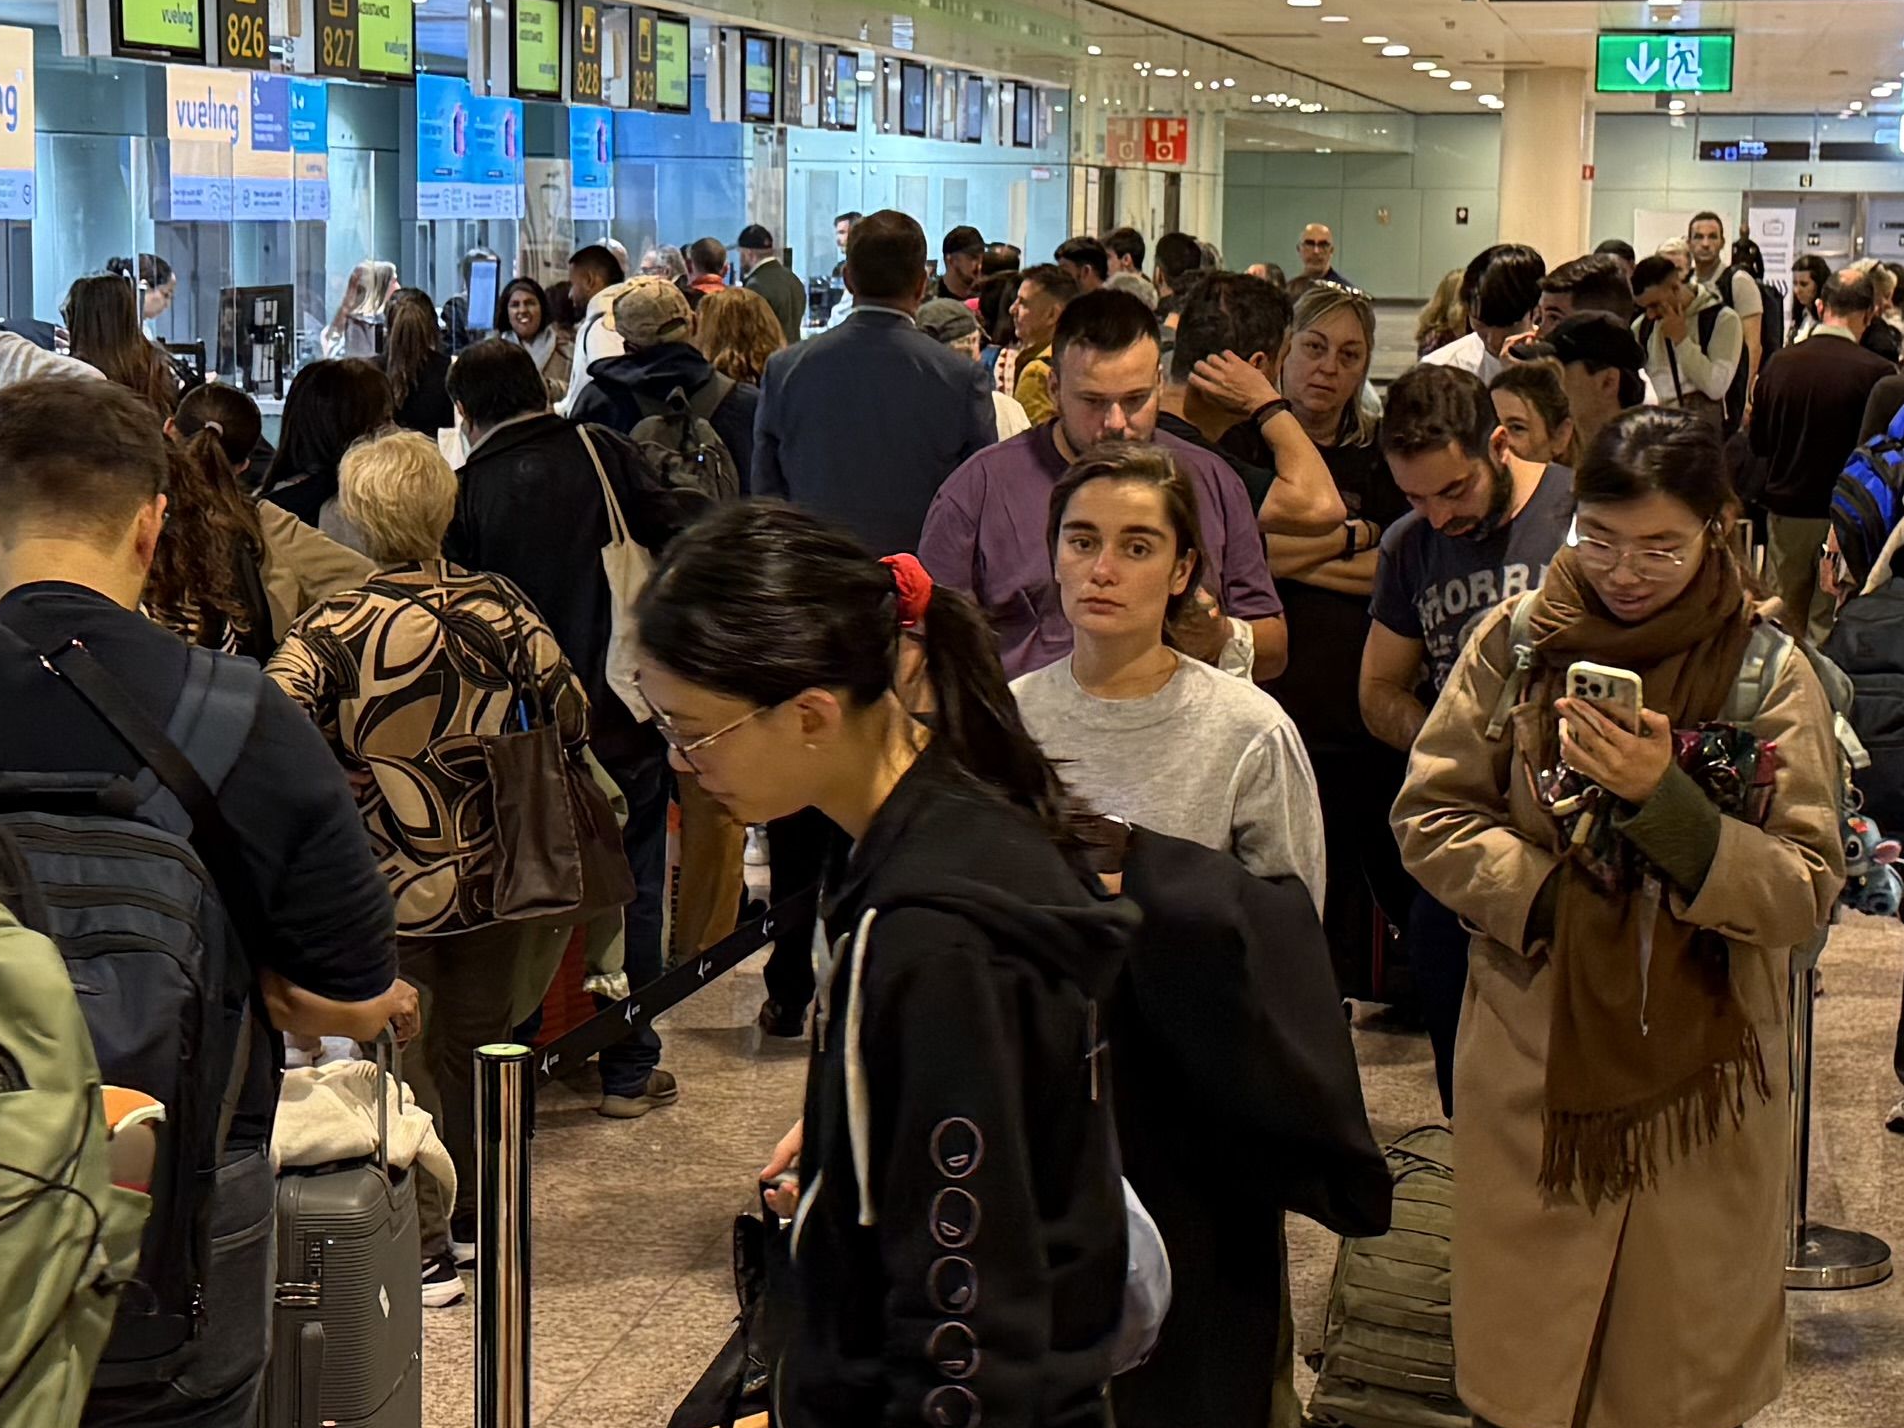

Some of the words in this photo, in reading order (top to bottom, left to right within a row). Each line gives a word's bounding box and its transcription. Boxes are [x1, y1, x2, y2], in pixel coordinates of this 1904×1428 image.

[227, 13, 264, 59] 826
[323, 26, 354, 67] 827
[577, 61, 599, 94] 828
[176, 86, 239, 144] vueling
